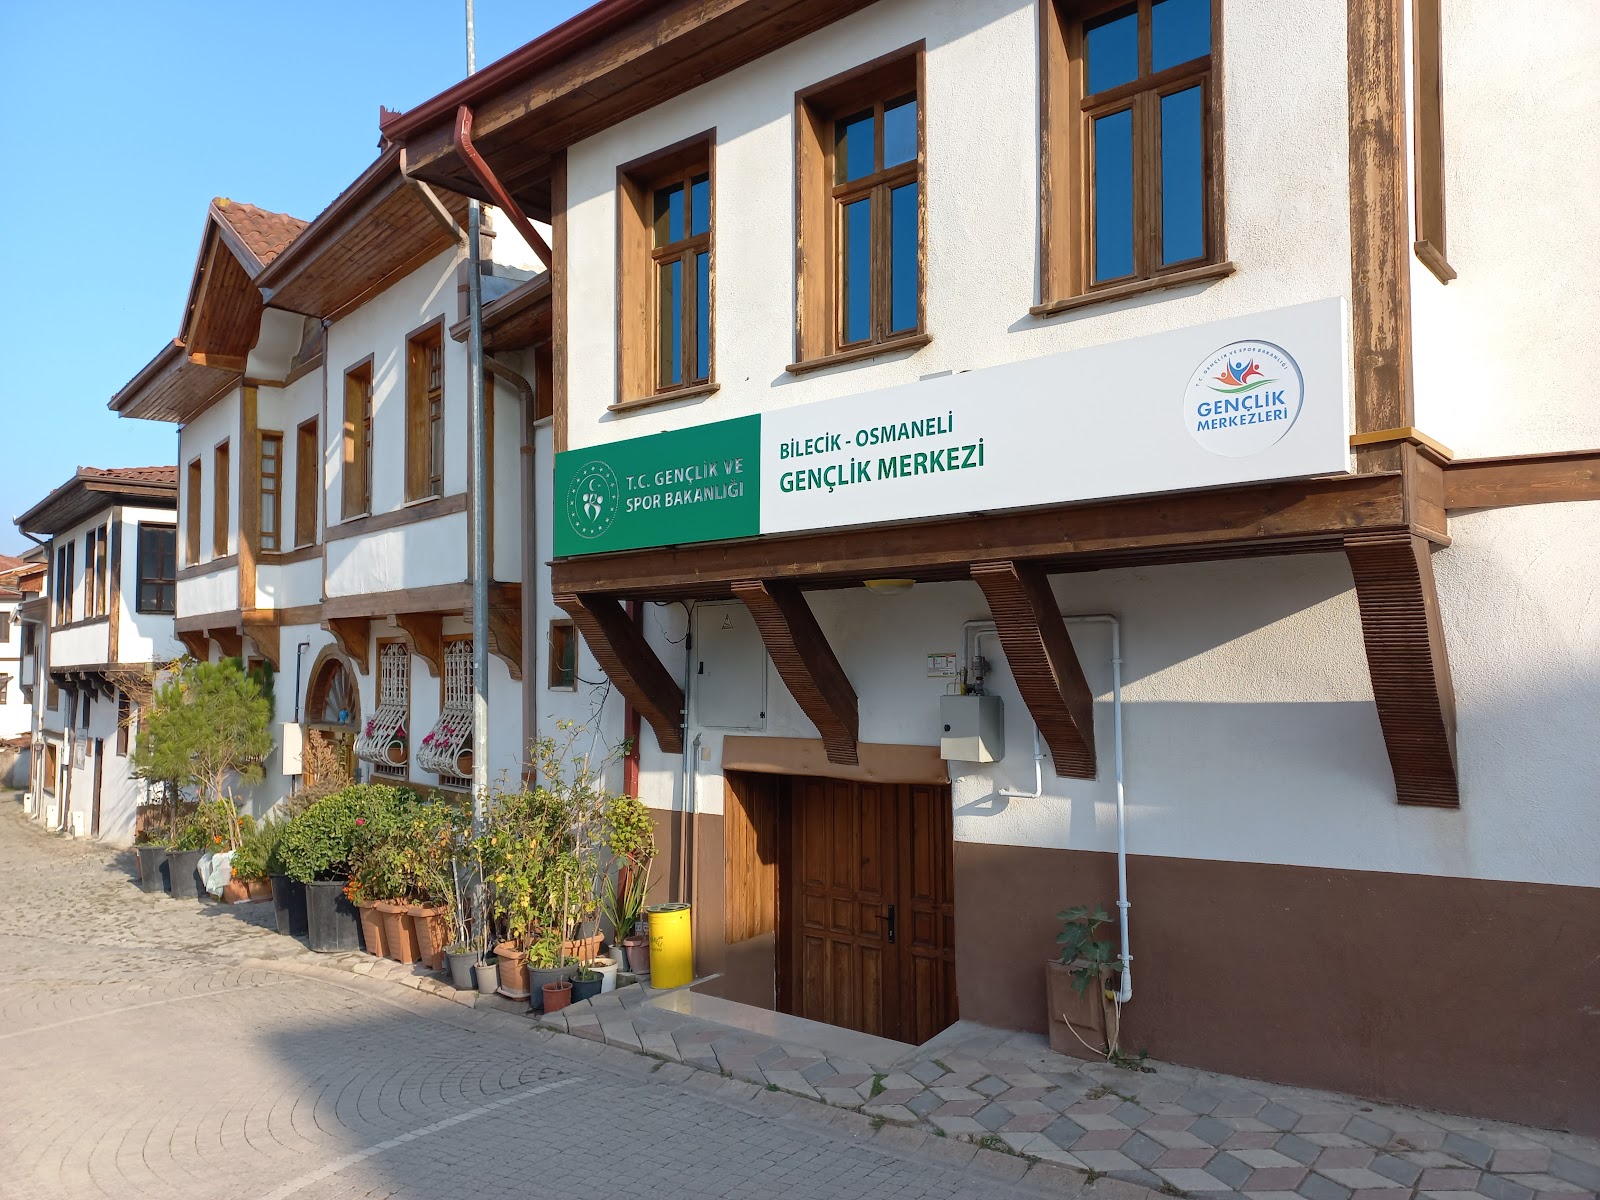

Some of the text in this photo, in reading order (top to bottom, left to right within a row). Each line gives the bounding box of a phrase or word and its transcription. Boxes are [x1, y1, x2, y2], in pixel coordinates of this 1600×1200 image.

[1197, 390, 1285, 416] GENÇLİK
[1197, 407, 1287, 431] MERKEZLERİ
[780, 433, 841, 459] BİLECİK
[855, 411, 953, 447] OSMANELİ
[626, 458, 743, 491] T.C. GENÇLİK VE
[780, 438, 984, 493] GENÇLİK MERKEZİ
[626, 478, 743, 512] SPOR BAKANLIĞI
